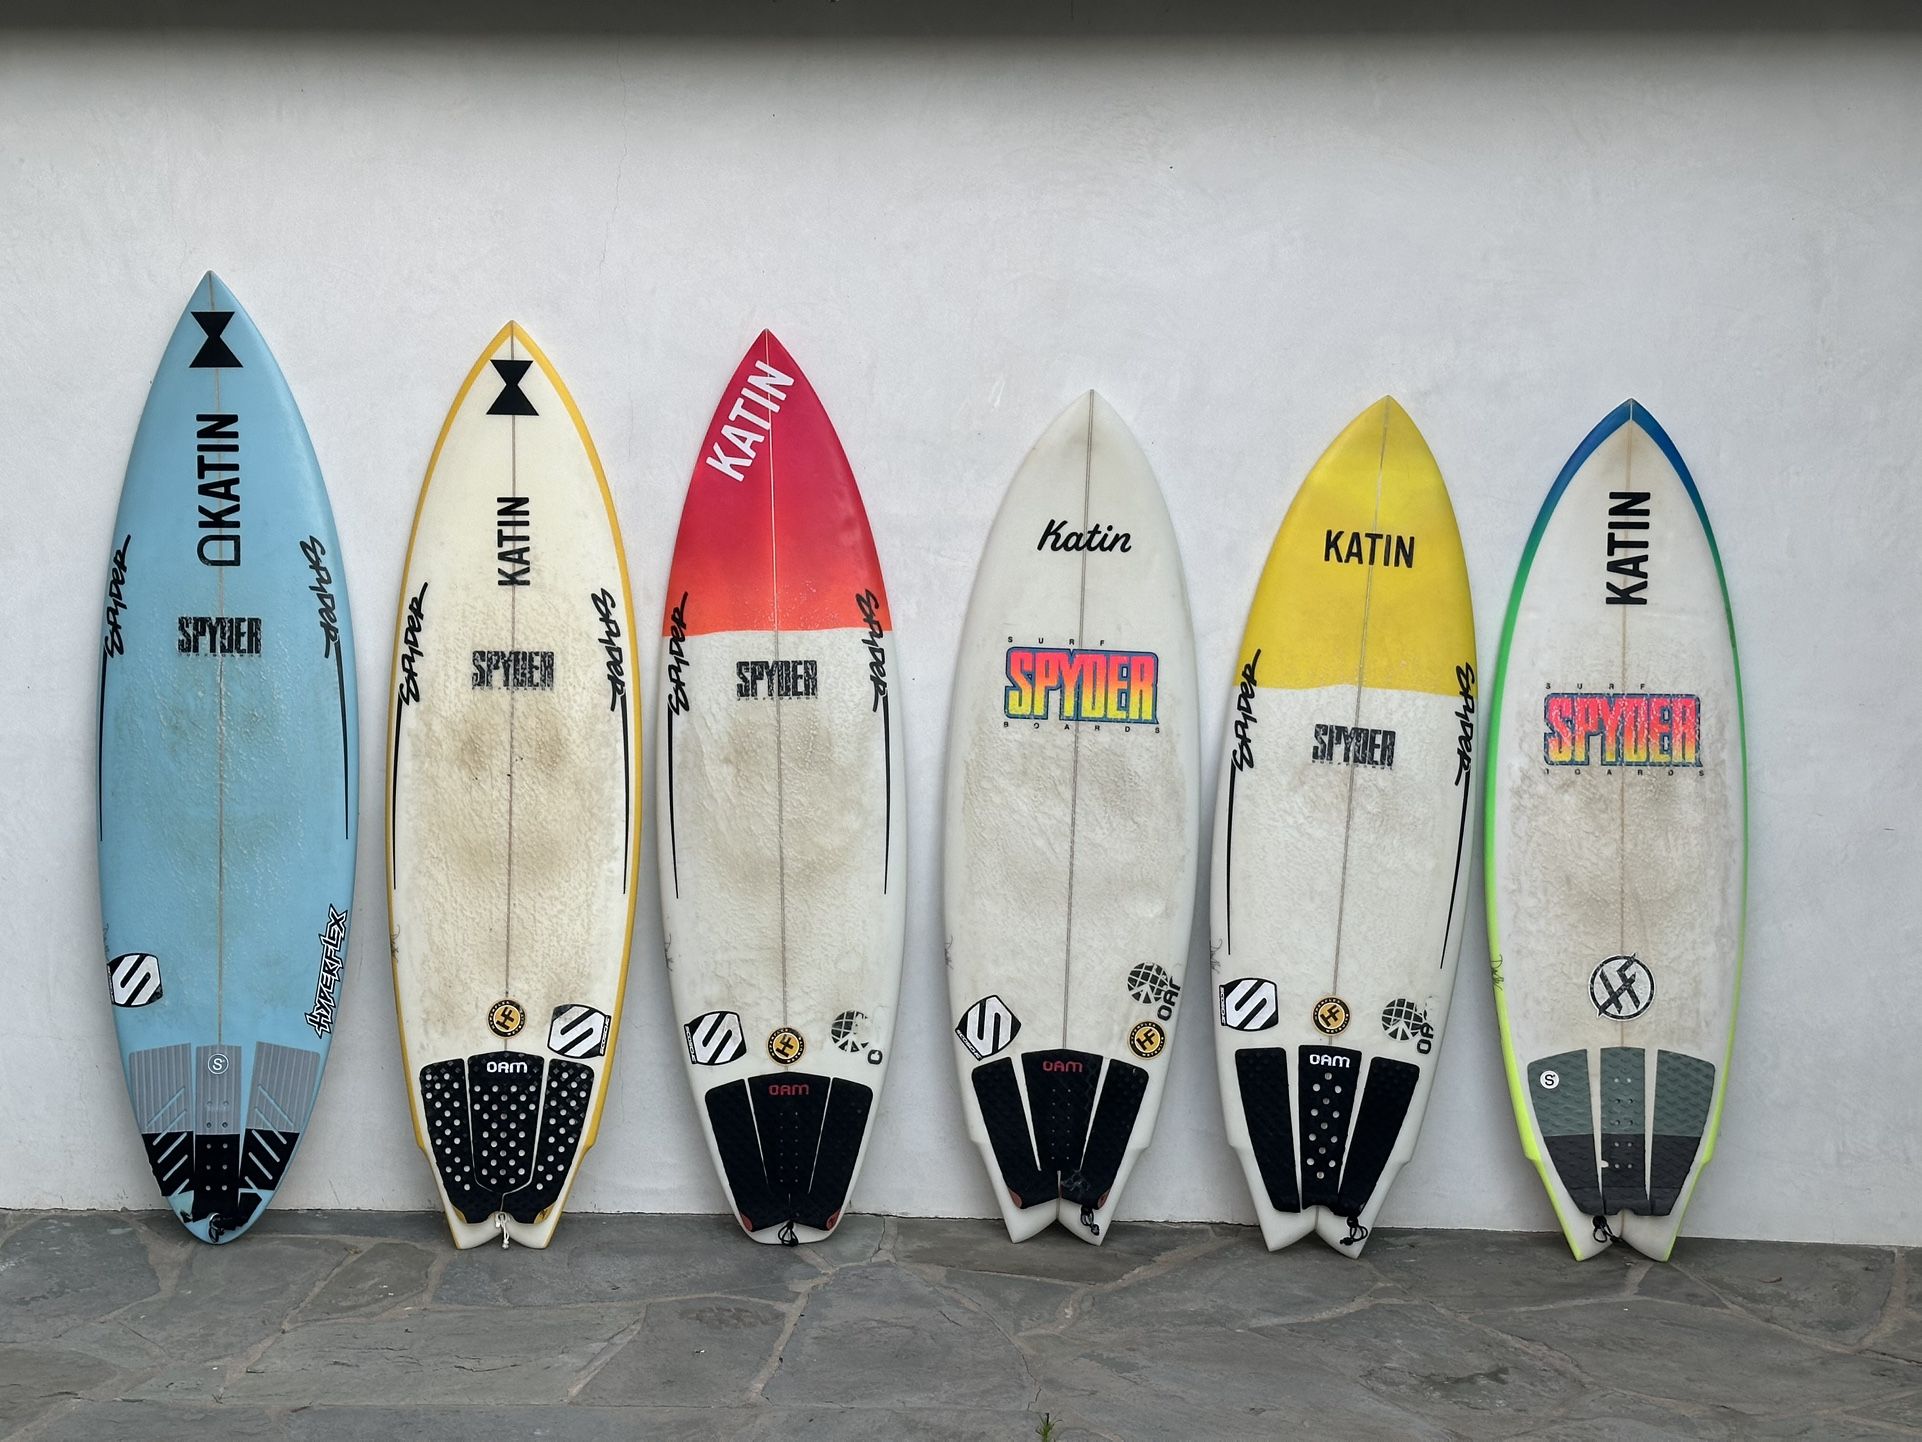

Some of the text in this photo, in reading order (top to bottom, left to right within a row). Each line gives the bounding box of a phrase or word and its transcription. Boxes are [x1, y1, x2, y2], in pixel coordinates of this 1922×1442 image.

[706, 360, 795, 481] KATIN
[496, 496, 531, 587] KATIN
[1037, 519, 1132, 553] Katin
[1323, 529, 1415, 568] KATIN
[1605, 491, 1651, 605] KATIN
[177, 616, 262, 654] SPYDER
[472, 650, 555, 688] SPYDER
[736, 660, 818, 698] SPYDER
[1003, 646, 1160, 725] SPYDER
[1311, 723, 1397, 767] SPYDER
[1543, 692, 1703, 768] SPYDER
[304, 902, 349, 1040] HYPERFLEX
[486, 1060, 528, 1074] OAM
[1042, 1060, 1083, 1073] OAM
[1309, 1053, 1351, 1069] OAM
[769, 1083, 810, 1096] OAM
